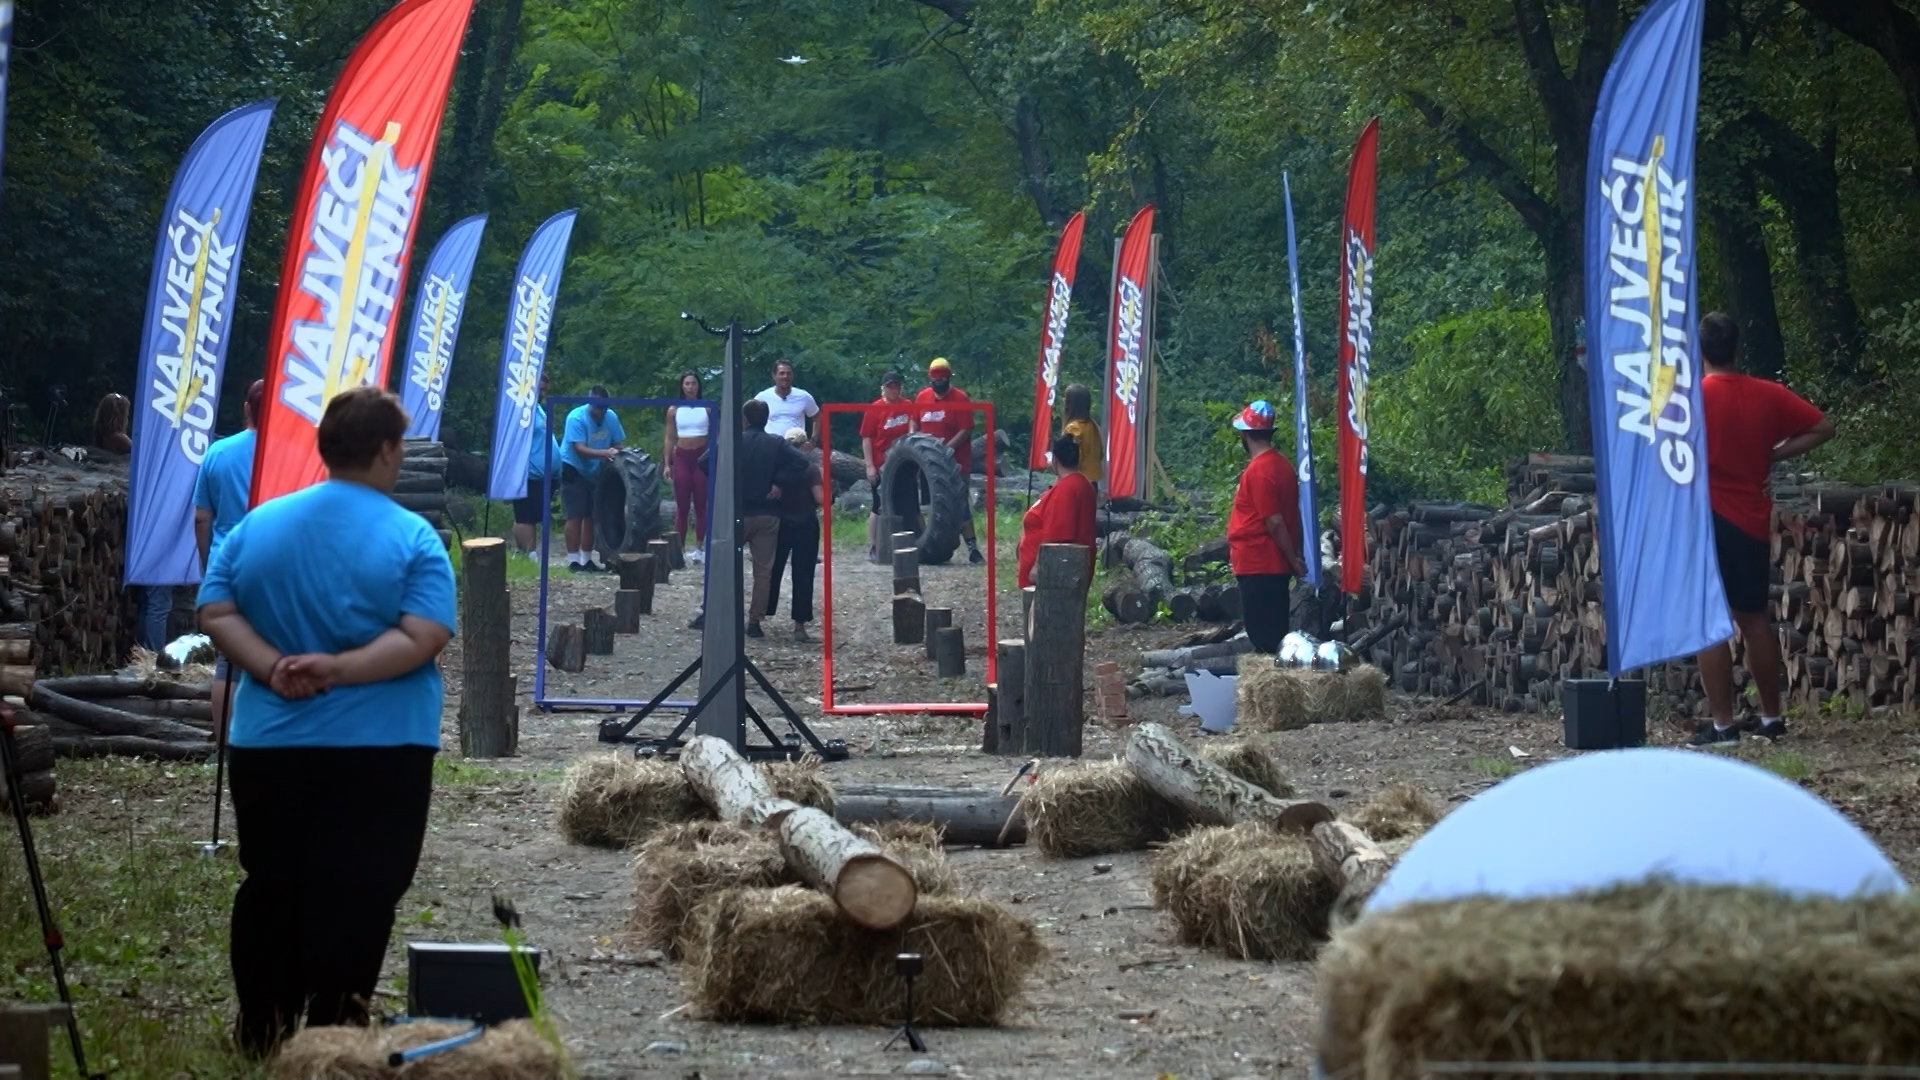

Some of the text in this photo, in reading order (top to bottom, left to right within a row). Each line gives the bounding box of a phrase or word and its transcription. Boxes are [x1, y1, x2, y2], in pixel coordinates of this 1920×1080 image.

[152, 208, 208, 428] NAJVEĆI
[180, 229, 236, 465] GUBITNIK
[283, 125, 373, 427] NAJVEĆI
[334, 146, 415, 387] BITNIK
[411, 273, 446, 392] NAJVEĆI
[427, 283, 463, 411] GUBITNIK
[506, 275, 538, 407] NAJVEĆI
[1601, 157, 1655, 445] NAJVEĆI
[1656, 166, 1694, 484] GUBITNIK
